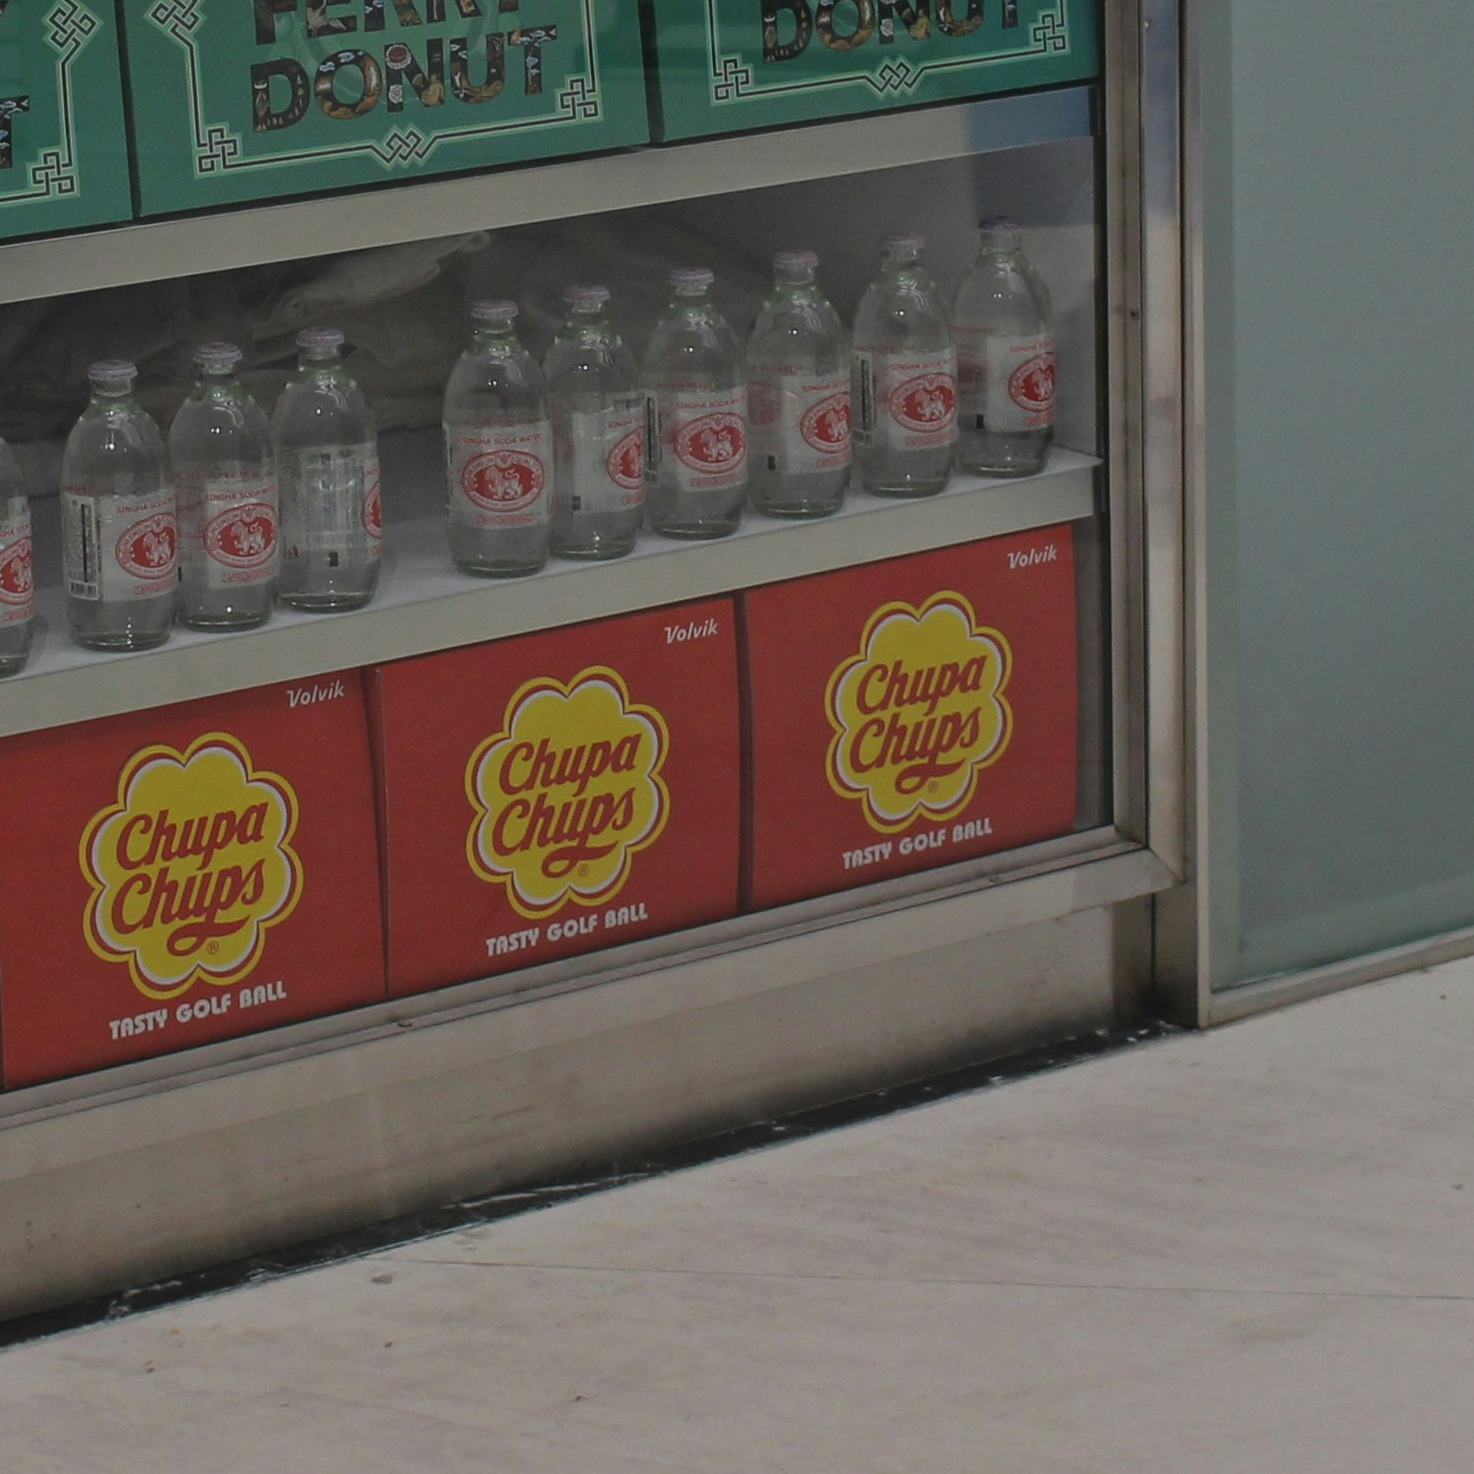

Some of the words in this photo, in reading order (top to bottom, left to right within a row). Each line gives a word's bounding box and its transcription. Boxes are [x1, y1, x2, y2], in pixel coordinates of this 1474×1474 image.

[249, 24, 557, 133] DONUT
[494, 437, 517, 445] SODA
[1007, 544, 1058, 570] Volvik
[664, 618, 719, 645] Volvik
[286, 680, 344, 708] Volvik
[856, 654, 987, 716] Chupa
[499, 732, 643, 797] Chupa
[849, 706, 982, 795] Chups
[116, 801, 269, 871] Chupa
[492, 786, 637, 879] Chups
[842, 841, 892, 870] TASTY
[899, 828, 947, 857] GOLF
[952, 817, 993, 844] BALL
[111, 858, 266, 956] Chups
[485, 927, 539, 958] TASTY
[546, 913, 598, 942] GOLF
[604, 902, 648, 928] BALL
[109, 1009, 168, 1040] TASTY
[176, 993, 231, 1023] GOLF
[239, 980, 286, 1009] BALL
